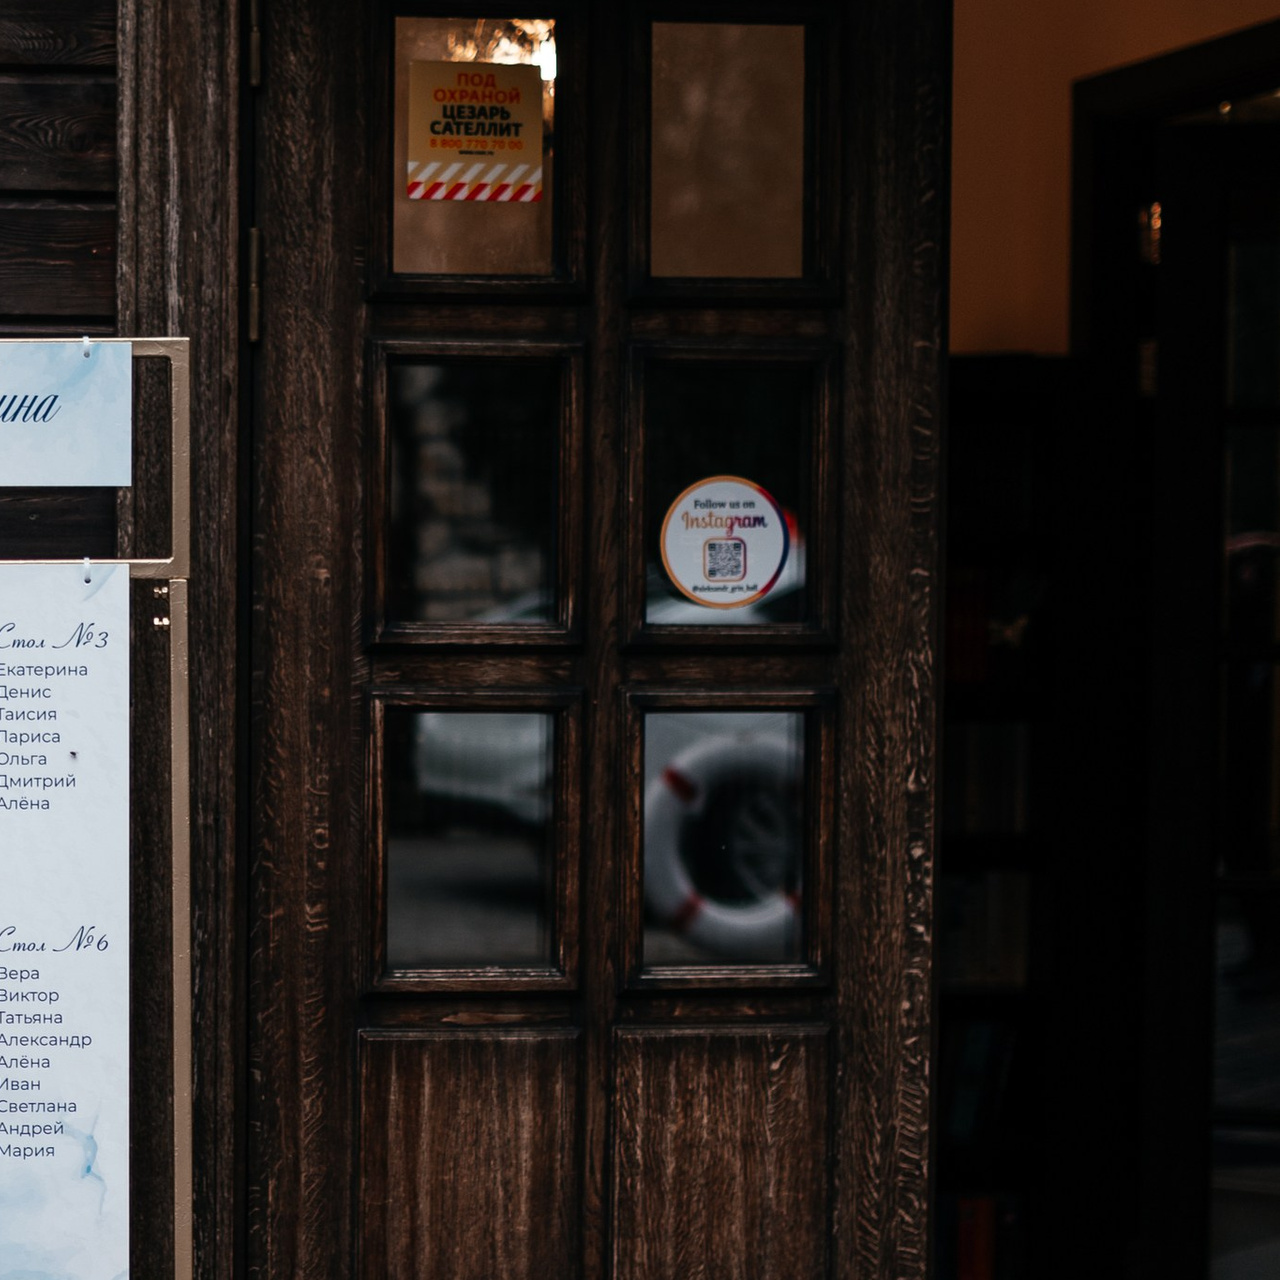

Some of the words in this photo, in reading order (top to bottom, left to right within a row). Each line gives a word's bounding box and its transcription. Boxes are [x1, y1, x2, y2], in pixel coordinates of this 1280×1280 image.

[457, 73, 496, 88] ПОД
[433, 87, 521, 104] ОХРАНОЙ
[442, 105, 511, 122] ЦЕЗАРЬ
[429, 121, 523, 137] САТЕЛЛИТ
[694, 499, 726, 509] Follow
[729, 501, 740, 509] us
[743, 501, 755, 509] on
[682, 511, 768, 537] Instagram
